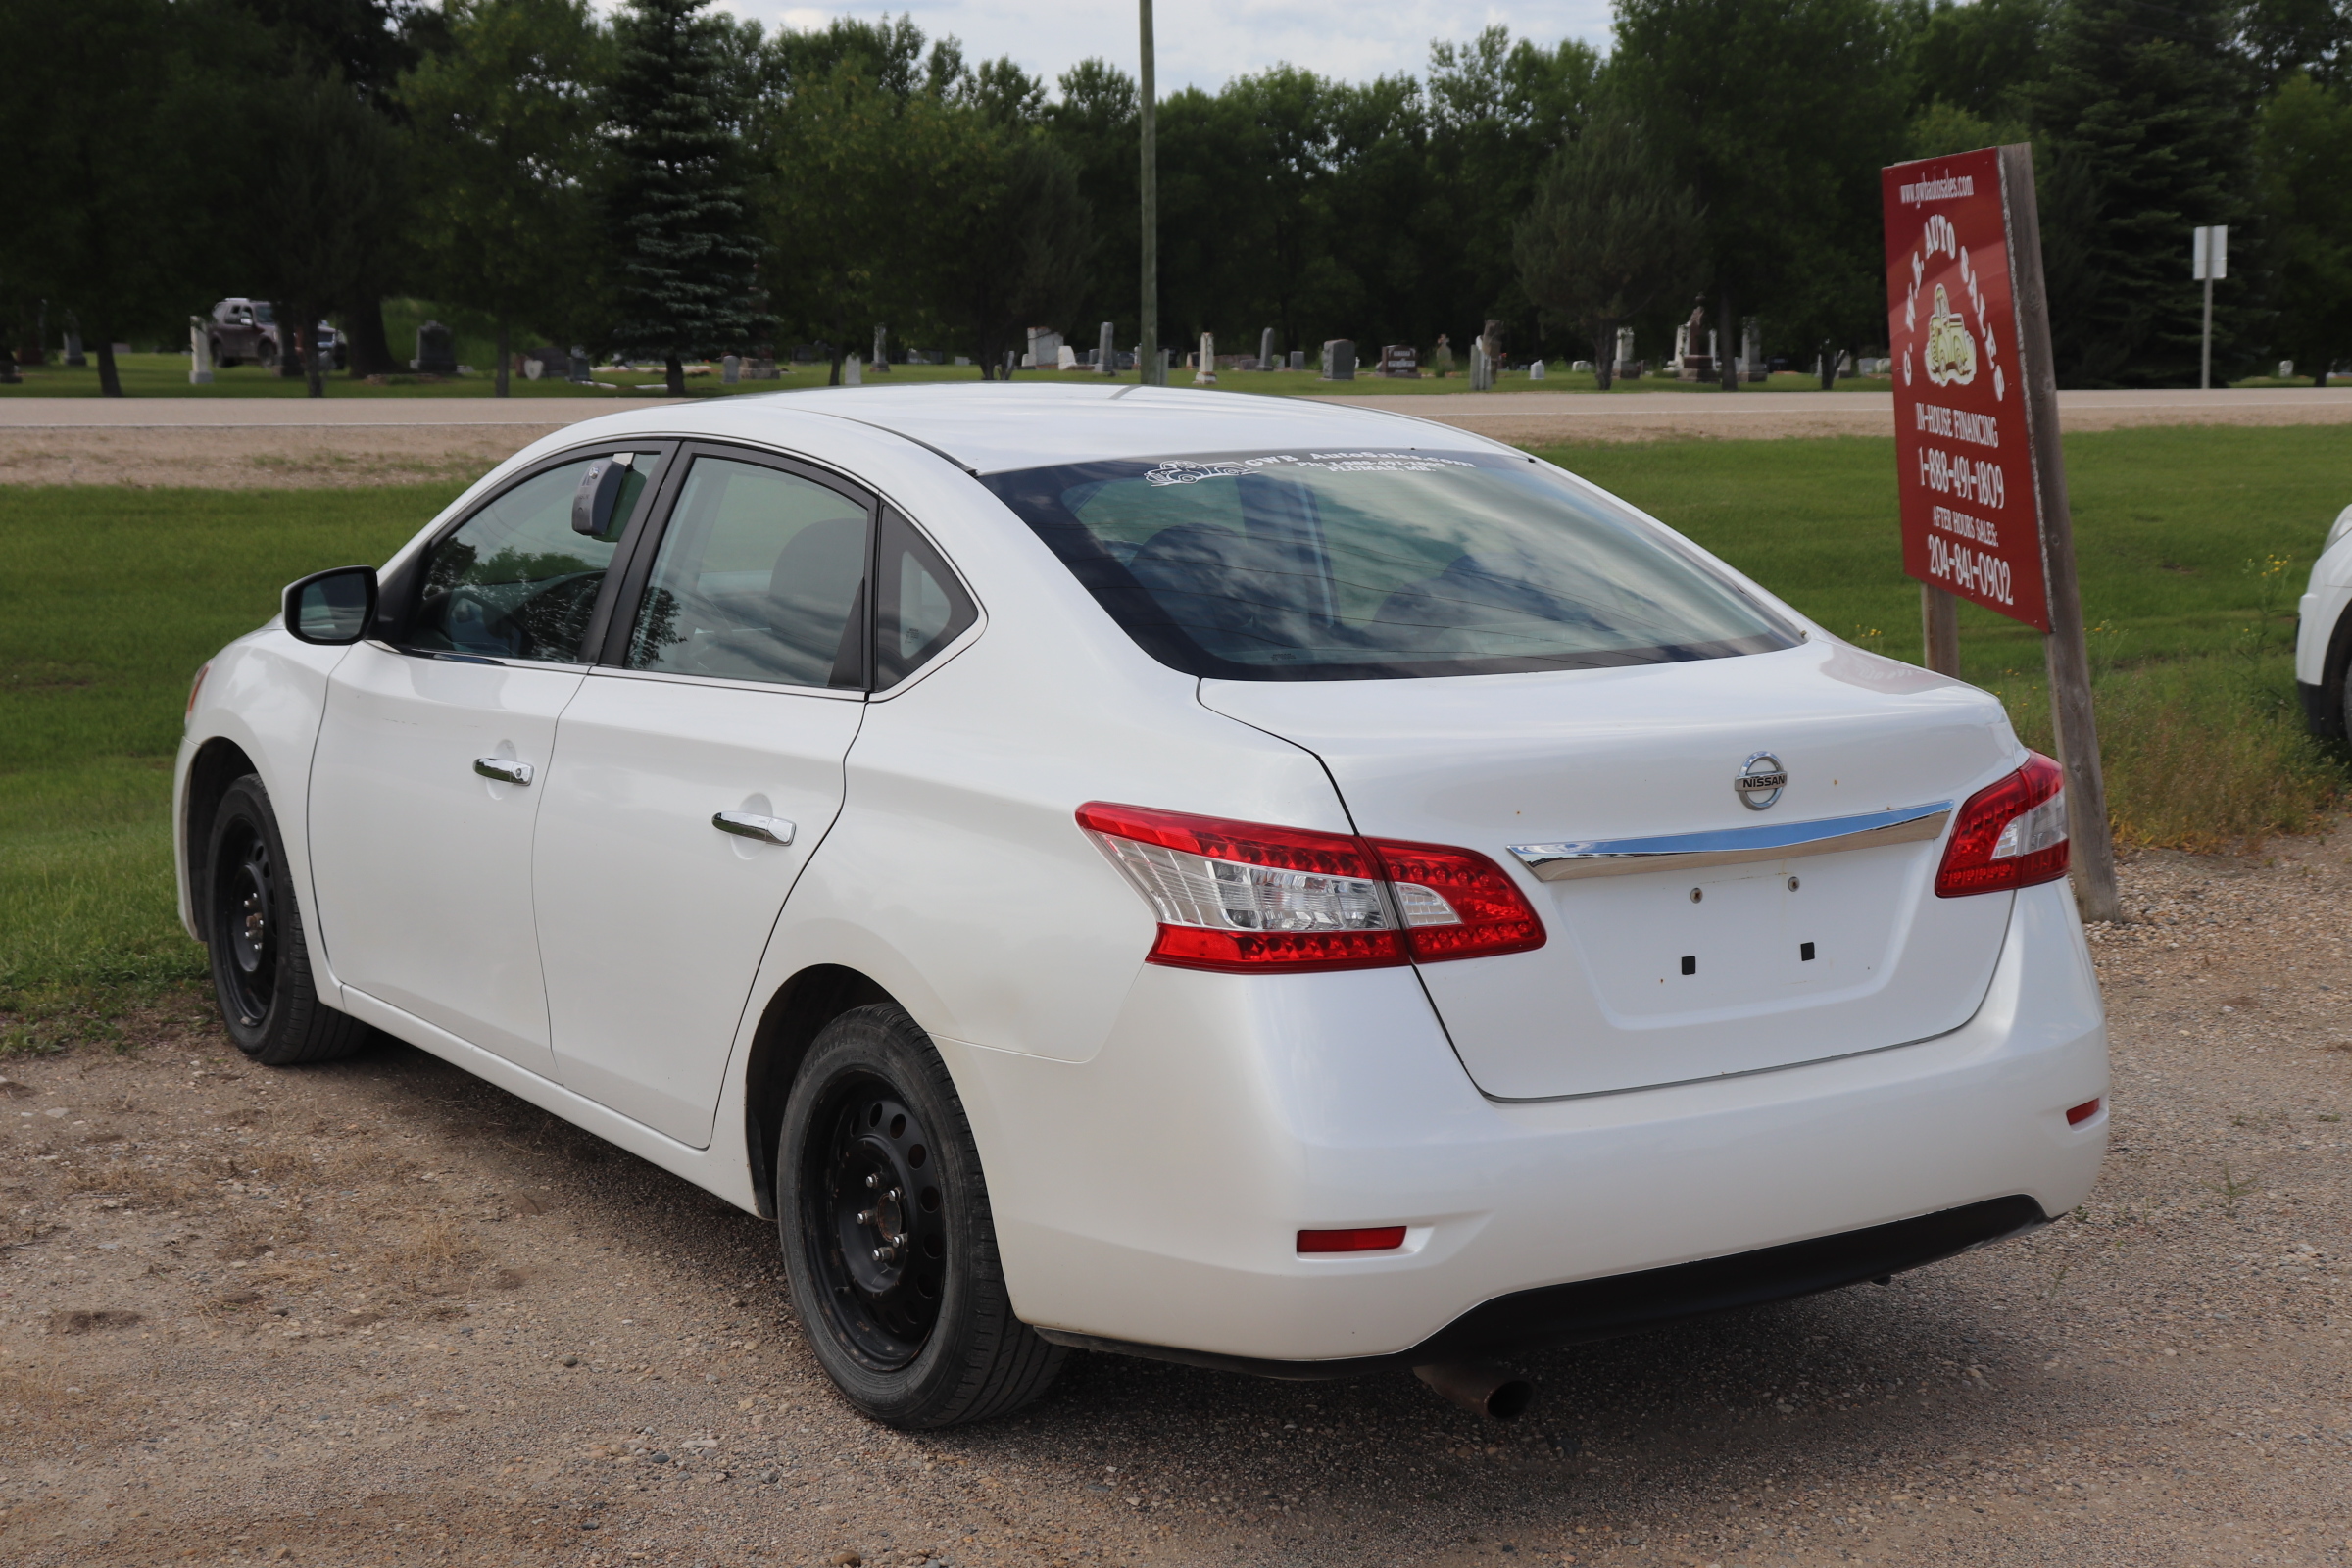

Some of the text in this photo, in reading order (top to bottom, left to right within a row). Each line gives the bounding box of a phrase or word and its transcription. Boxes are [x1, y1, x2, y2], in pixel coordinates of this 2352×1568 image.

[1924, 214, 1956, 260] AUTO
[1959, 245, 2005, 402] SALES
[1915, 402, 1999, 448] IN-HOUSE FINANCING
[1245, 451, 1477, 468] GWB AutoSales.com
[1918, 446, 2004, 510] 1-888-491-1809
[1933, 505, 1999, 547] AFTER HOURS SALES:
[1928, 534, 2014, 606] 204-841-0902
[1742, 775, 1786, 788] NISSAN
